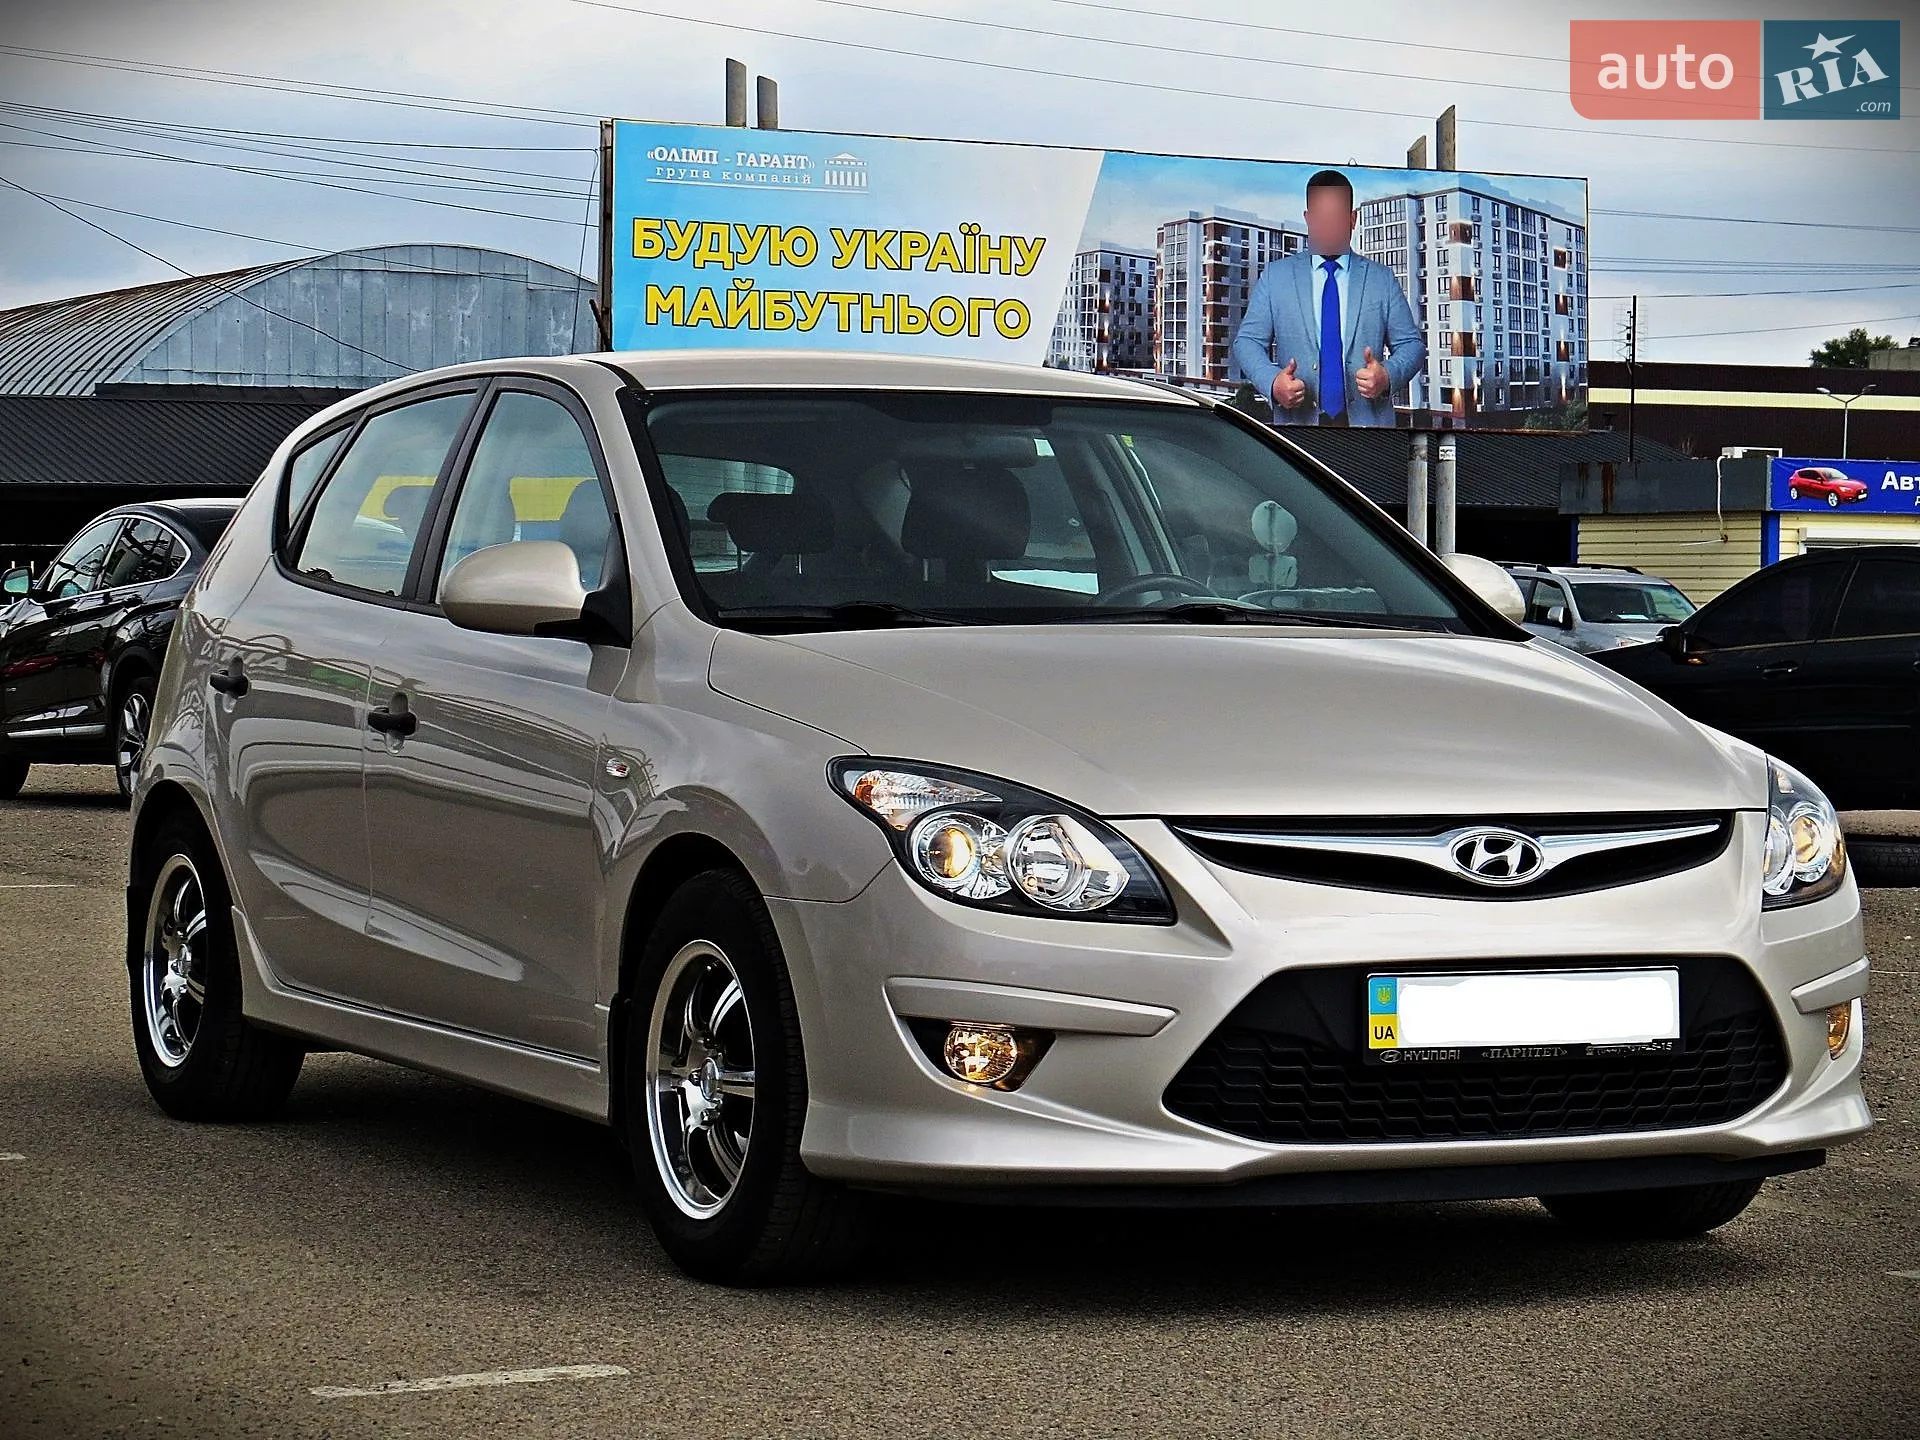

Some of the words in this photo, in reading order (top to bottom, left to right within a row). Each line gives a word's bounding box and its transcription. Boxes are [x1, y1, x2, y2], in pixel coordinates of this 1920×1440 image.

[647, 145, 719, 165] «ОЛІМП
[736, 151, 815, 170] ГАРАНТ»
[655, 166, 712, 180] група
[722, 170, 812, 185] компаній
[632, 217, 818, 271] БУДУЮ
[830, 222, 1046, 277] УКРАЇНУ
[645, 278, 1031, 340] МАЙБУТНЬОГО
[1374, 1025, 1395, 1040] UA
[1403, 1049, 1461, 1061] HYUNDAI
